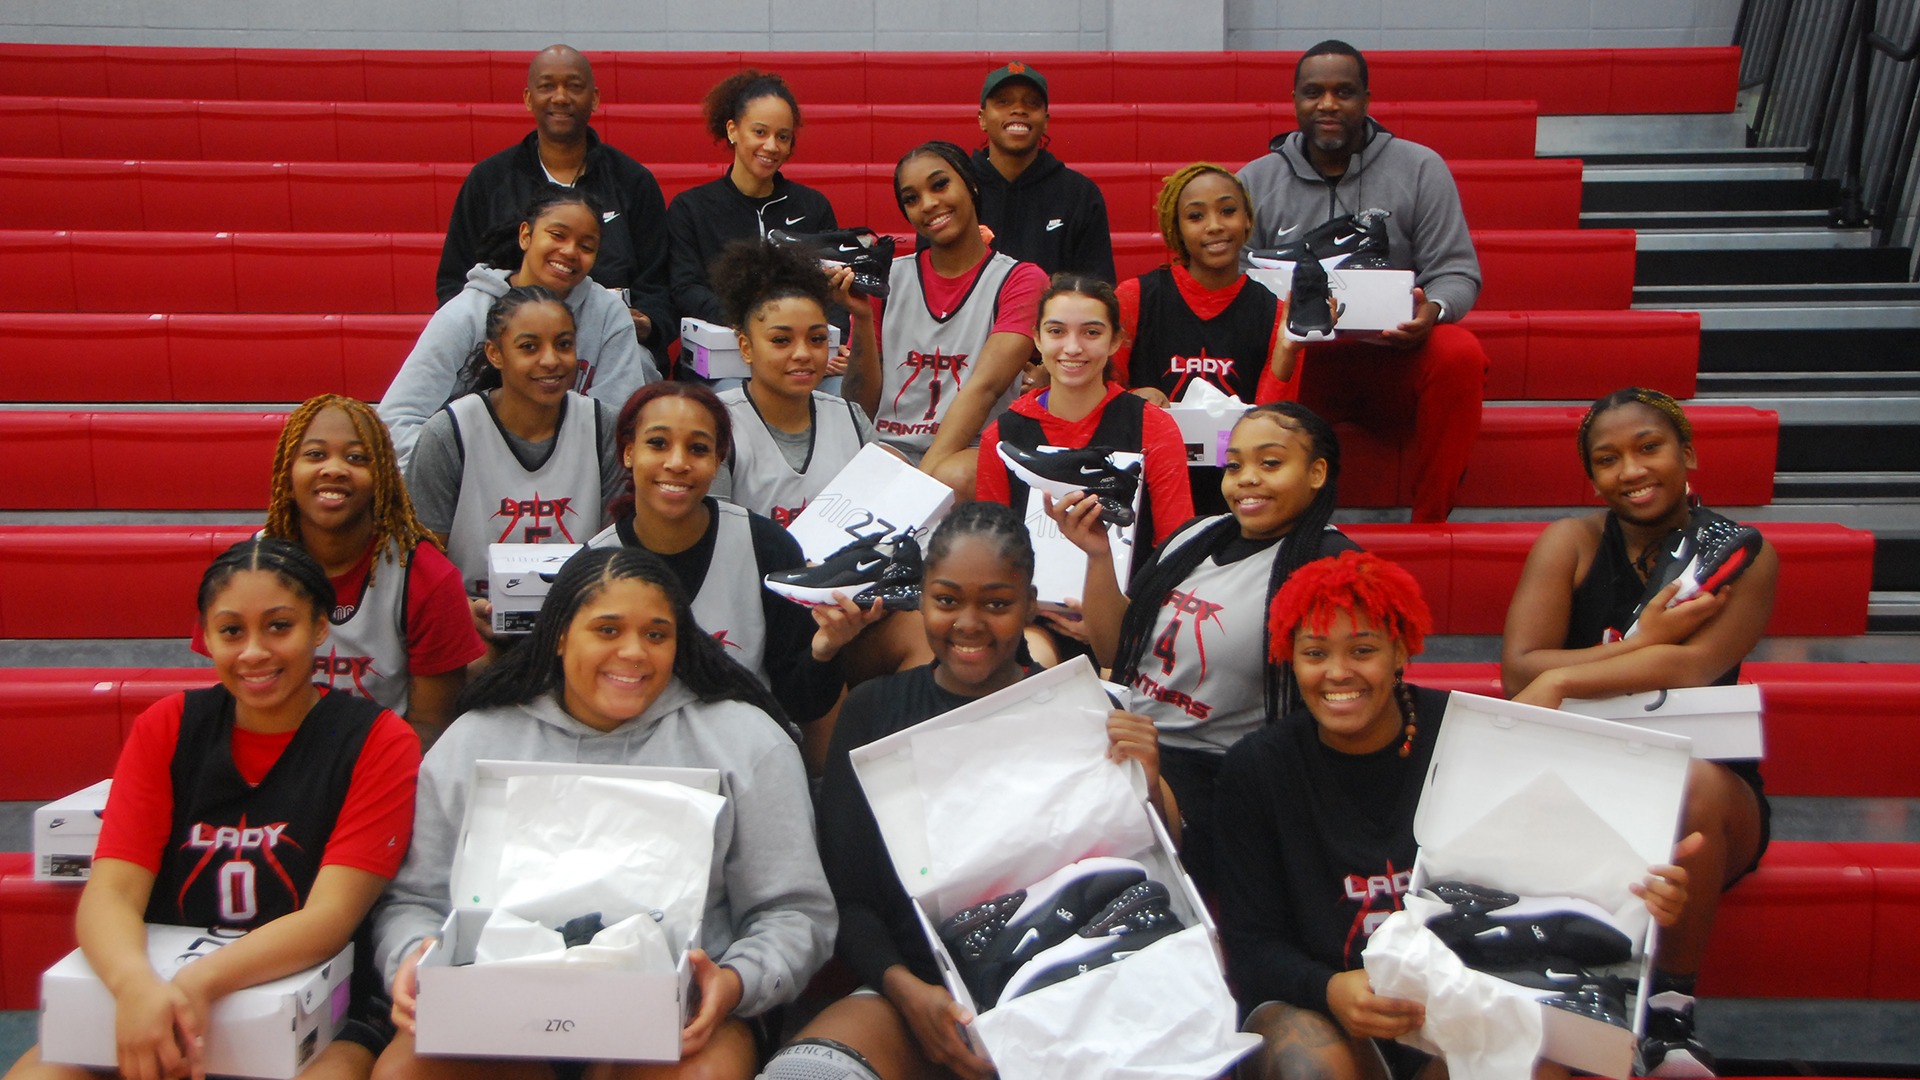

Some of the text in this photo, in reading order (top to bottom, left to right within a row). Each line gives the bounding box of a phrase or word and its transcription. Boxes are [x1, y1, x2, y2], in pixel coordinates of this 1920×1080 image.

[907, 351, 968, 371] LADY
[1170, 356, 1234, 376] LADY
[923, 380, 941, 421] 1
[875, 419, 940, 436] PANTH
[500, 497, 572, 519] LADY
[1161, 589, 1224, 621] ADY
[1152, 618, 1183, 677] 4
[312, 656, 375, 678] ADY
[1132, 672, 1214, 720] NTHERS
[190, 822, 289, 850] LADY
[218, 859, 258, 921] 0
[1344, 871, 1412, 898] LAD
